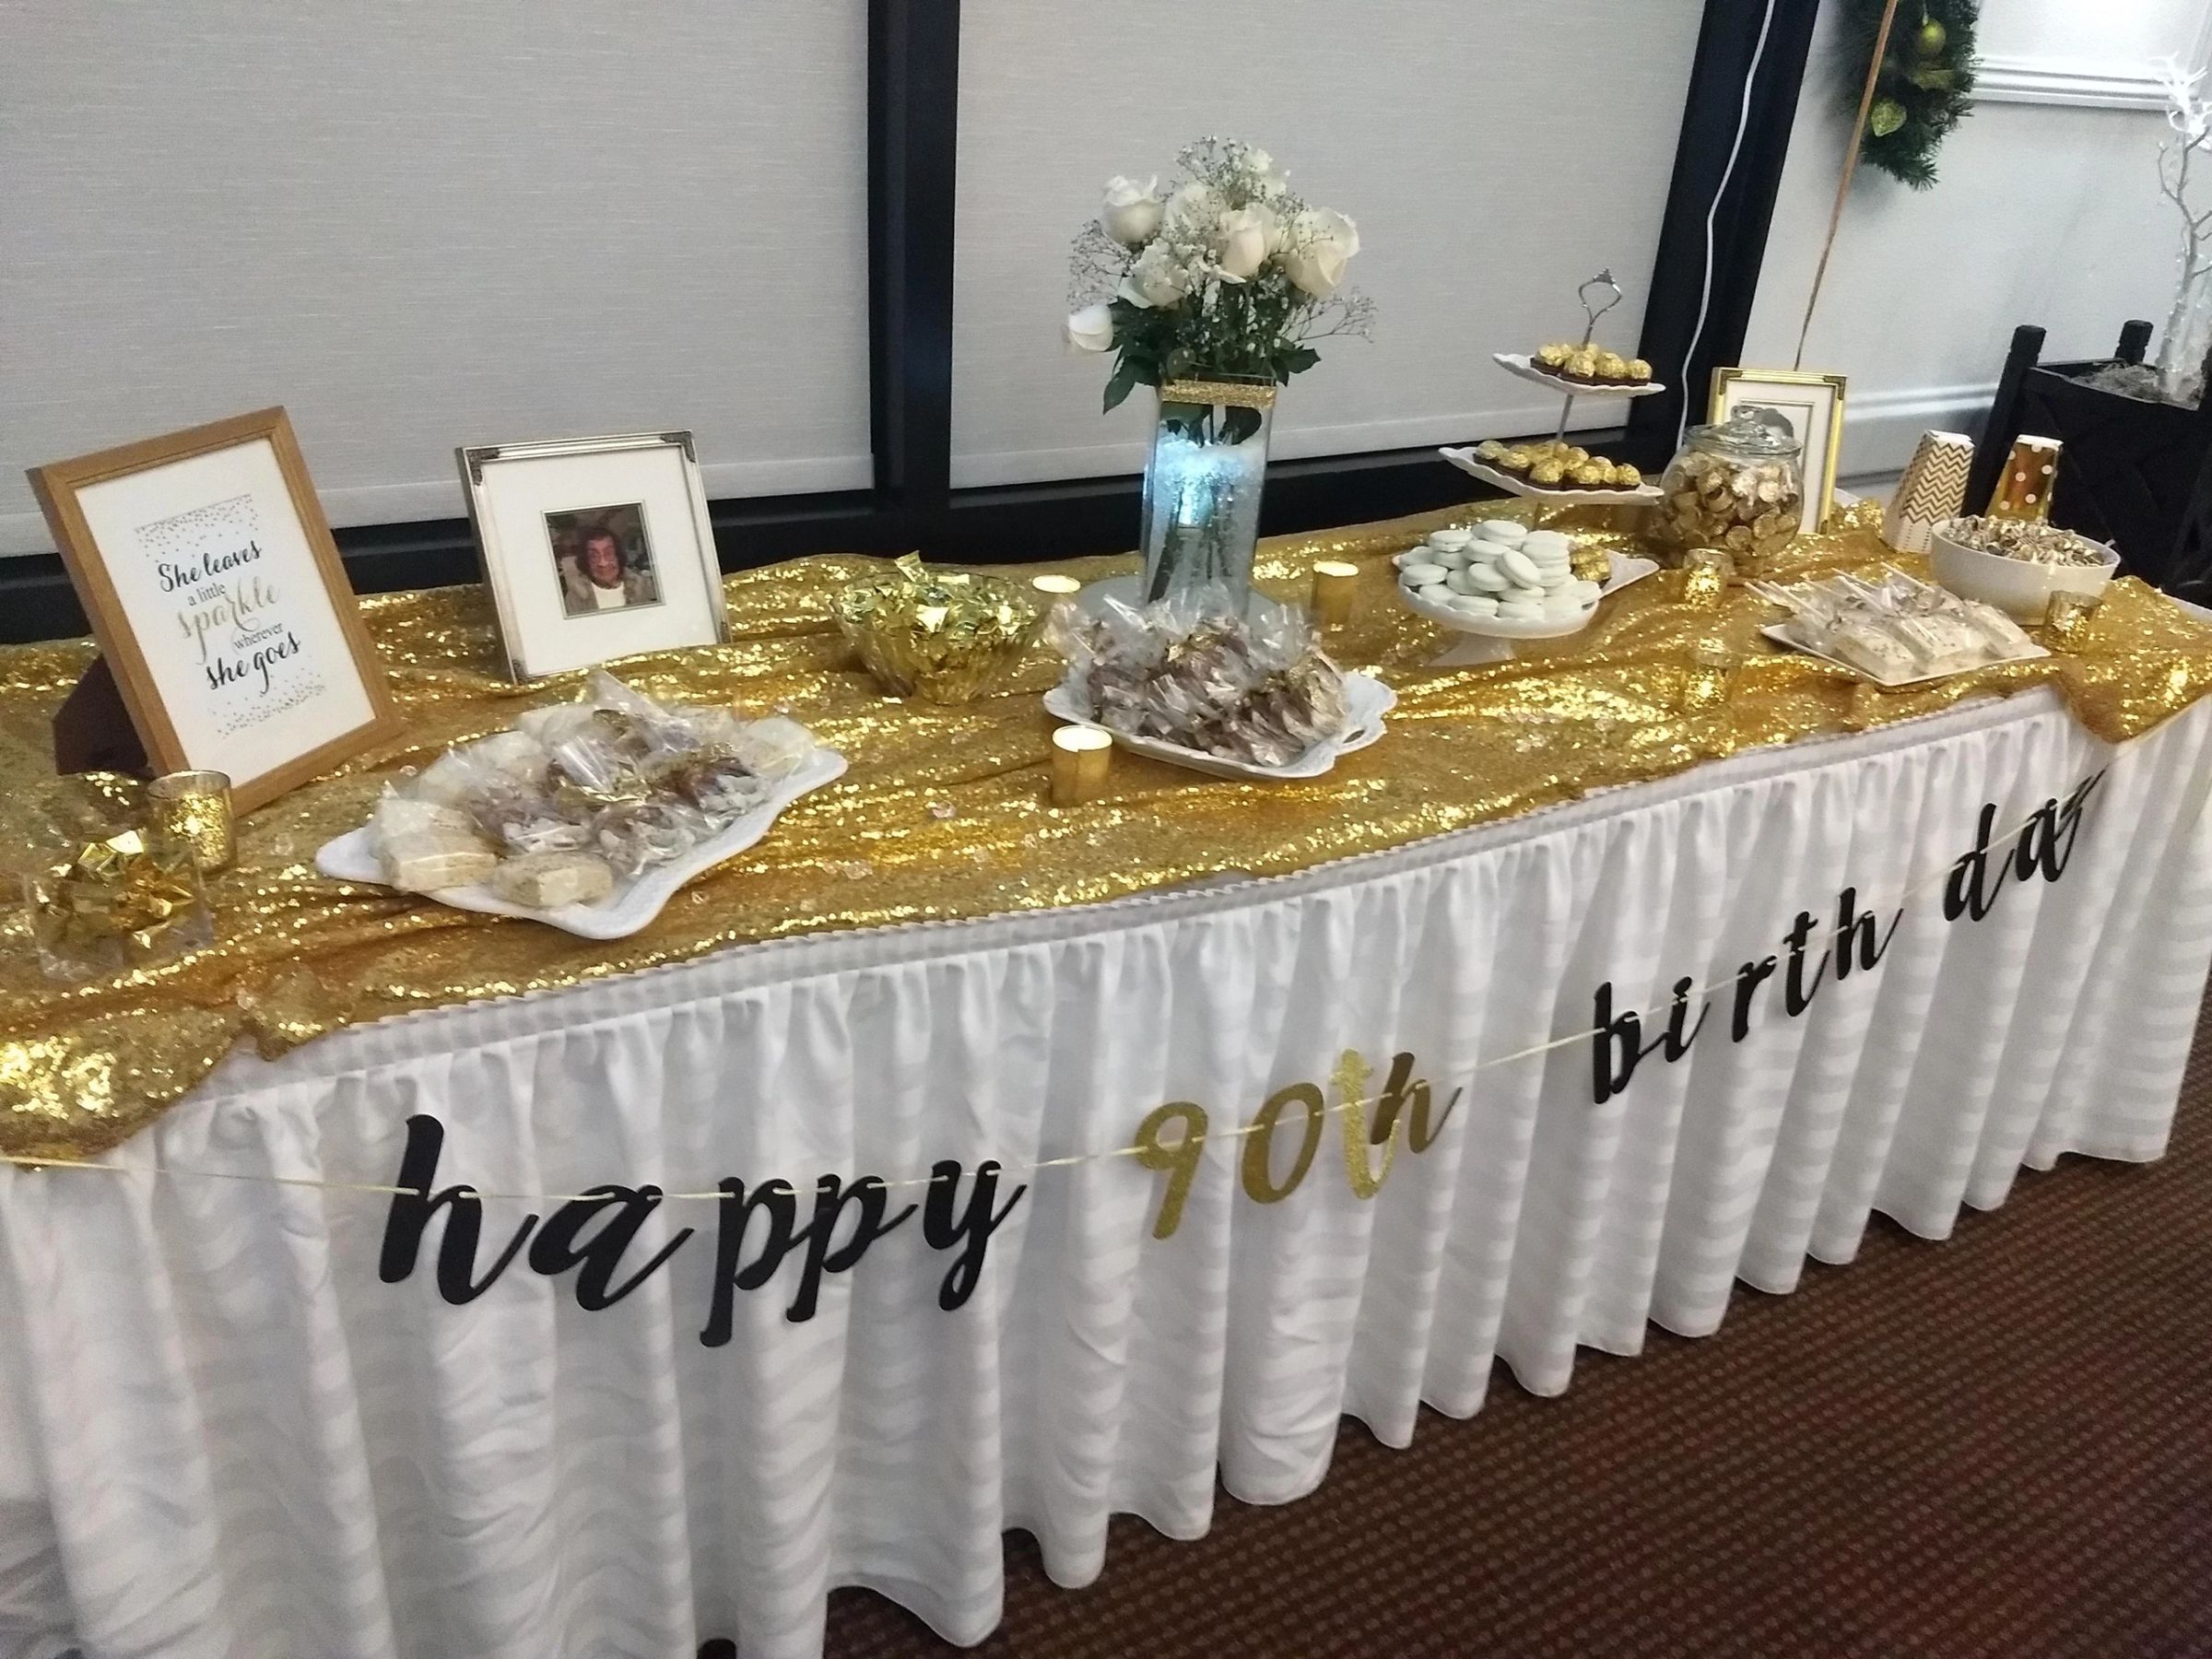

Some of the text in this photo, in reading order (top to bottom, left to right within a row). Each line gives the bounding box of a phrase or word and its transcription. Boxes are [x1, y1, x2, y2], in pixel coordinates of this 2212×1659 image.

[158, 540, 263, 592] She leaves
[187, 582, 226, 606] a little
[177, 576, 279, 665] sparkle
[233, 622, 283, 650] wherever
[206, 631, 300, 694] she goes
[379, 1113, 1027, 1347] happy
[1134, 1048, 1464, 1240] 90th
